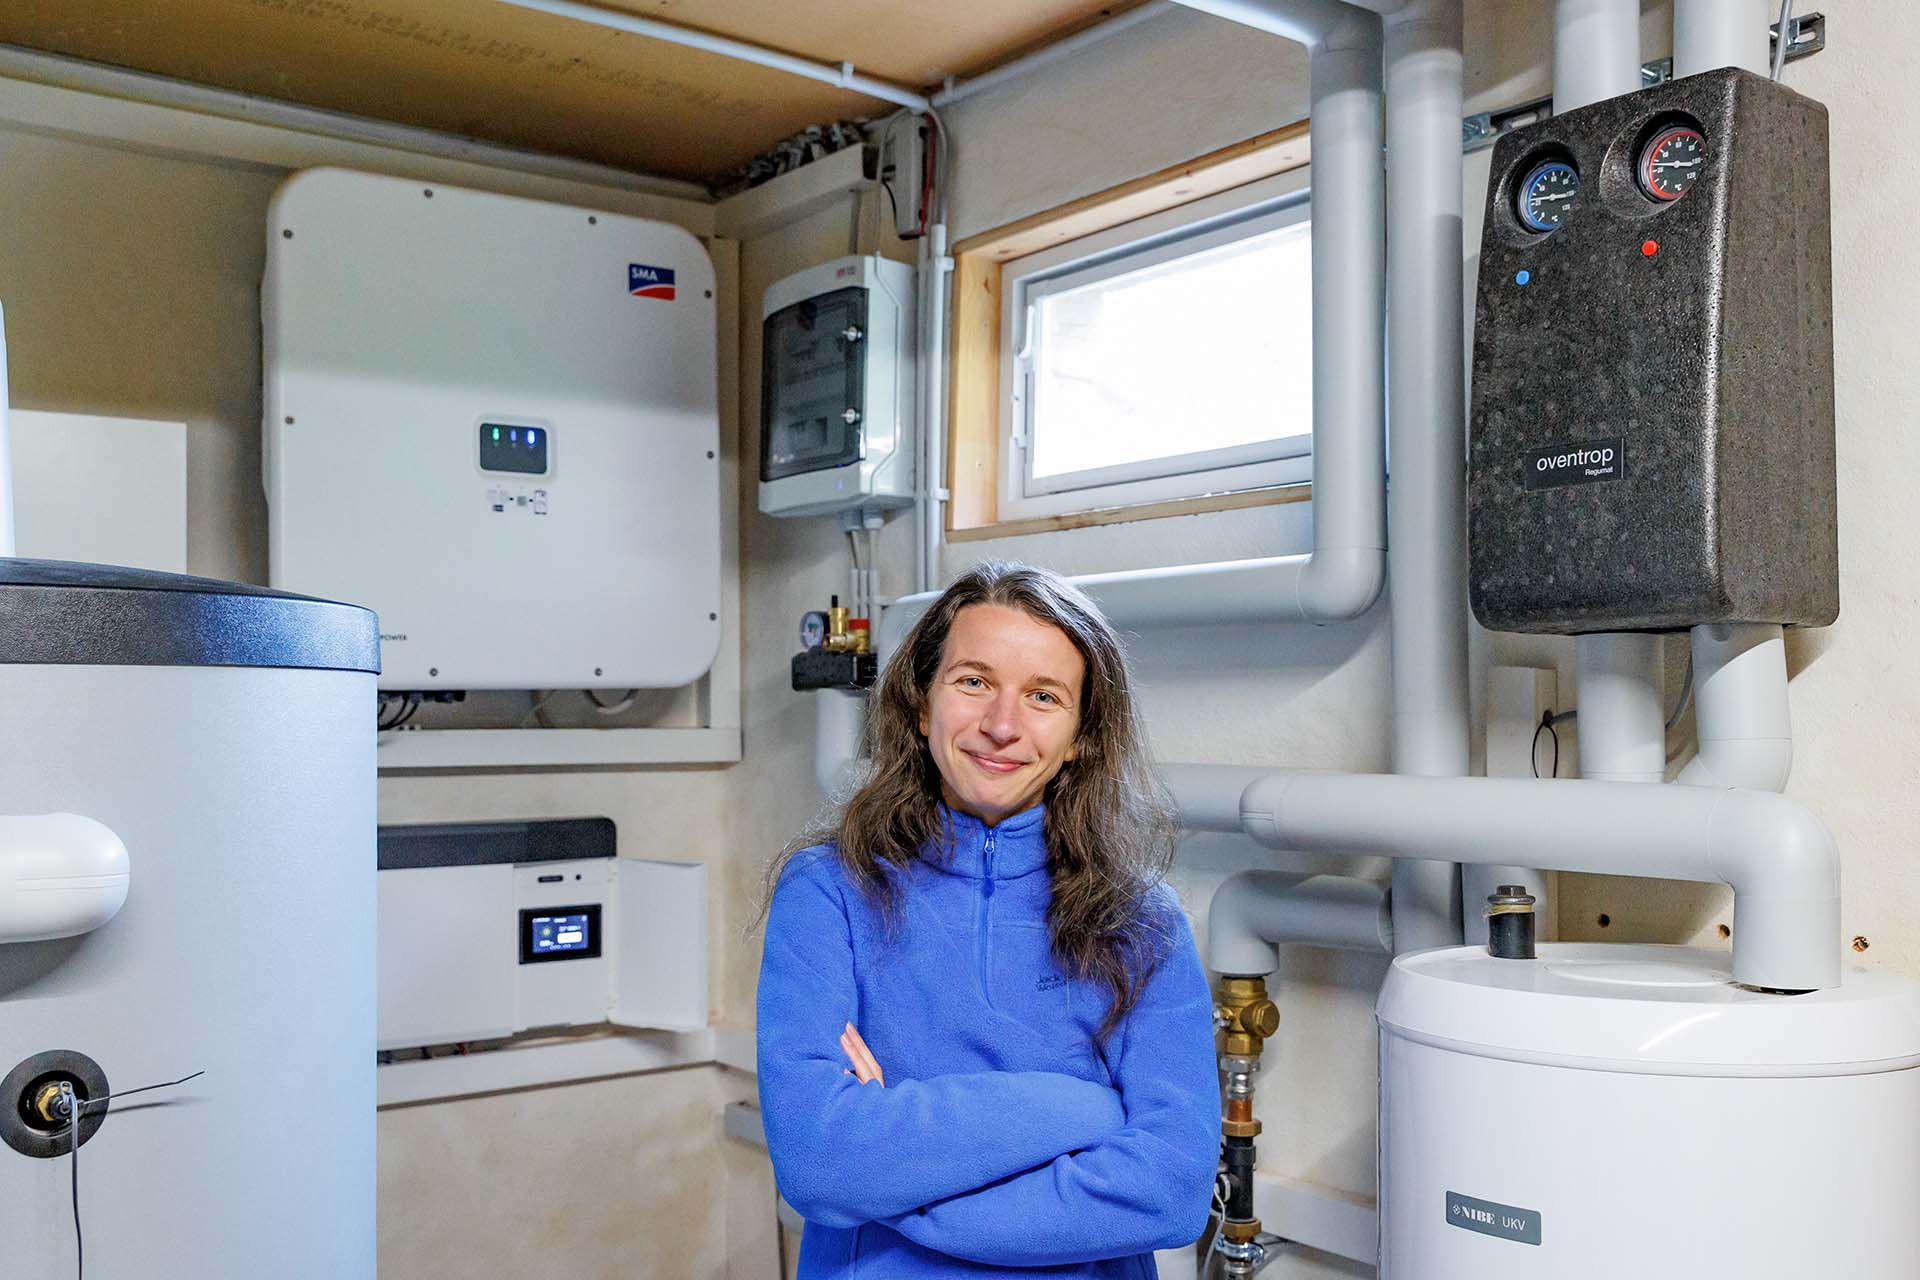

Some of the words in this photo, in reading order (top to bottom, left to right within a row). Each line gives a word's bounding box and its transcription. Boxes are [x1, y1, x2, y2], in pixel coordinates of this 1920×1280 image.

[631, 266, 659, 281] SMA
[1536, 448, 1614, 471] oventrop
[1585, 466, 1614, 476] Regumat
[1035, 974, 1061, 984] Jack
[1462, 1206, 1496, 1225] NIBE
[1502, 1216, 1526, 1231] UKV
